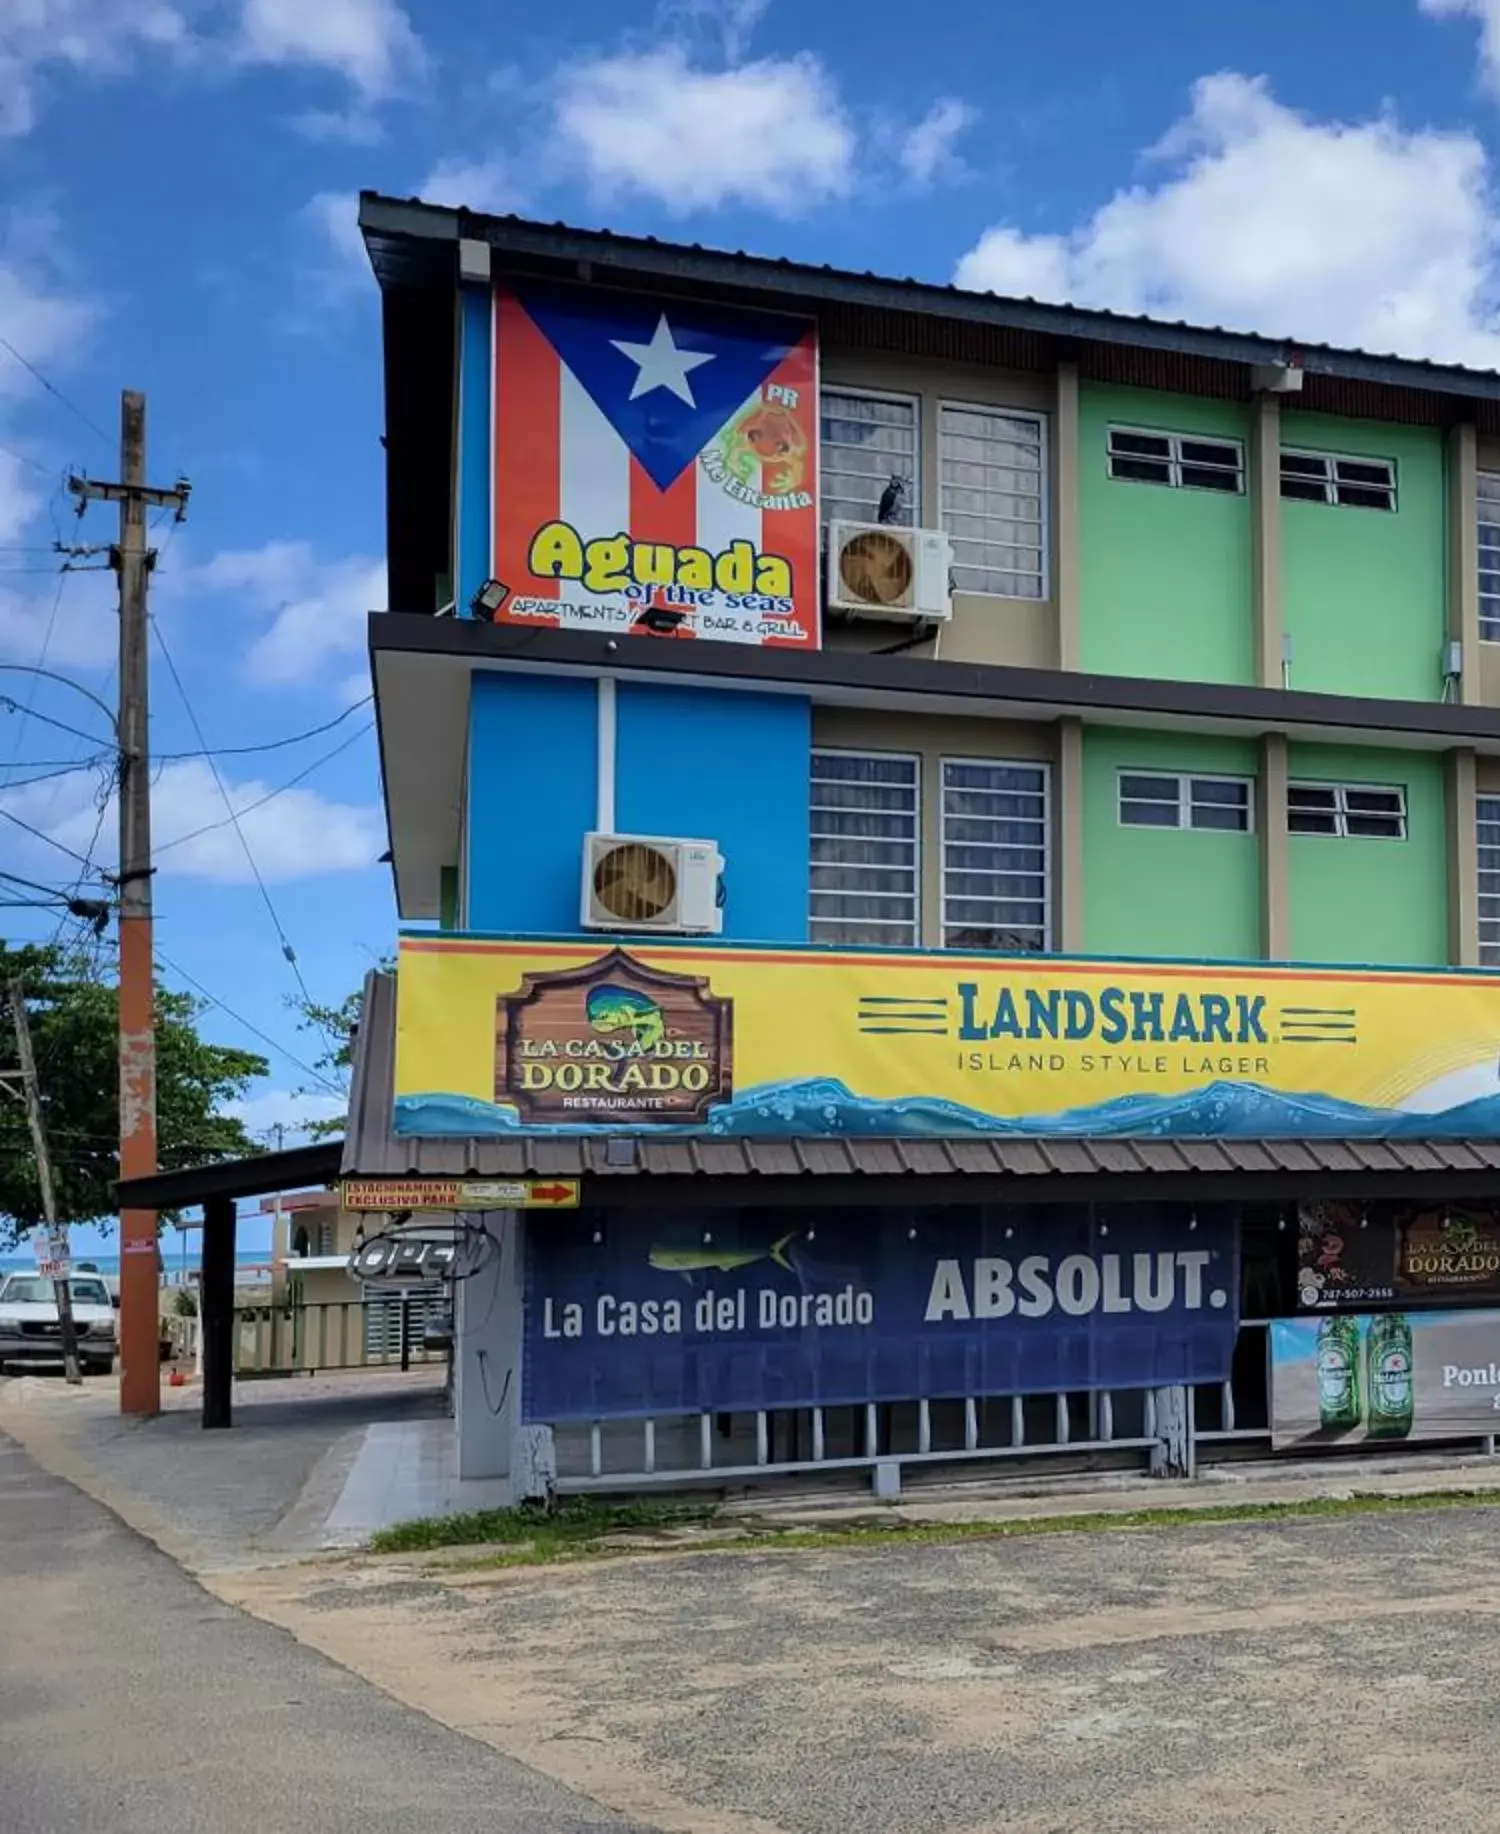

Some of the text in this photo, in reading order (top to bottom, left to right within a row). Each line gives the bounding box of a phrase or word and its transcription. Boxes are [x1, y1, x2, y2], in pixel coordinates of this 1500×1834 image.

[767, 383, 799, 409] PR
[700, 449, 813, 509] Me Encanta
[529, 520, 793, 598] Aguada
[624, 583, 793, 612] of the seas
[511, 598, 627, 622] APARTMENTS
[703, 614, 737, 631] BAR
[757, 620, 806, 637] GRILL
[957, 983, 1269, 1044] LANDSHARK
[521, 1038, 709, 1061] LA CASA DEL
[957, 1052, 1270, 1074] ISLAND STYLE LAGER
[520, 1062, 710, 1093] DORADO
[563, 1096, 664, 1109] RESTAURANTE
[347, 1182, 458, 1194] ESTACIONAMIENTO
[347, 1194, 456, 1206] EXCLUSIVO PARA
[358, 1228, 494, 1279] OPEN
[1407, 1255, 1500, 1274] DORADO
[924, 1250, 1227, 1321] ABSOLUT.
[544, 1284, 873, 1337] La Casa del Dorado
